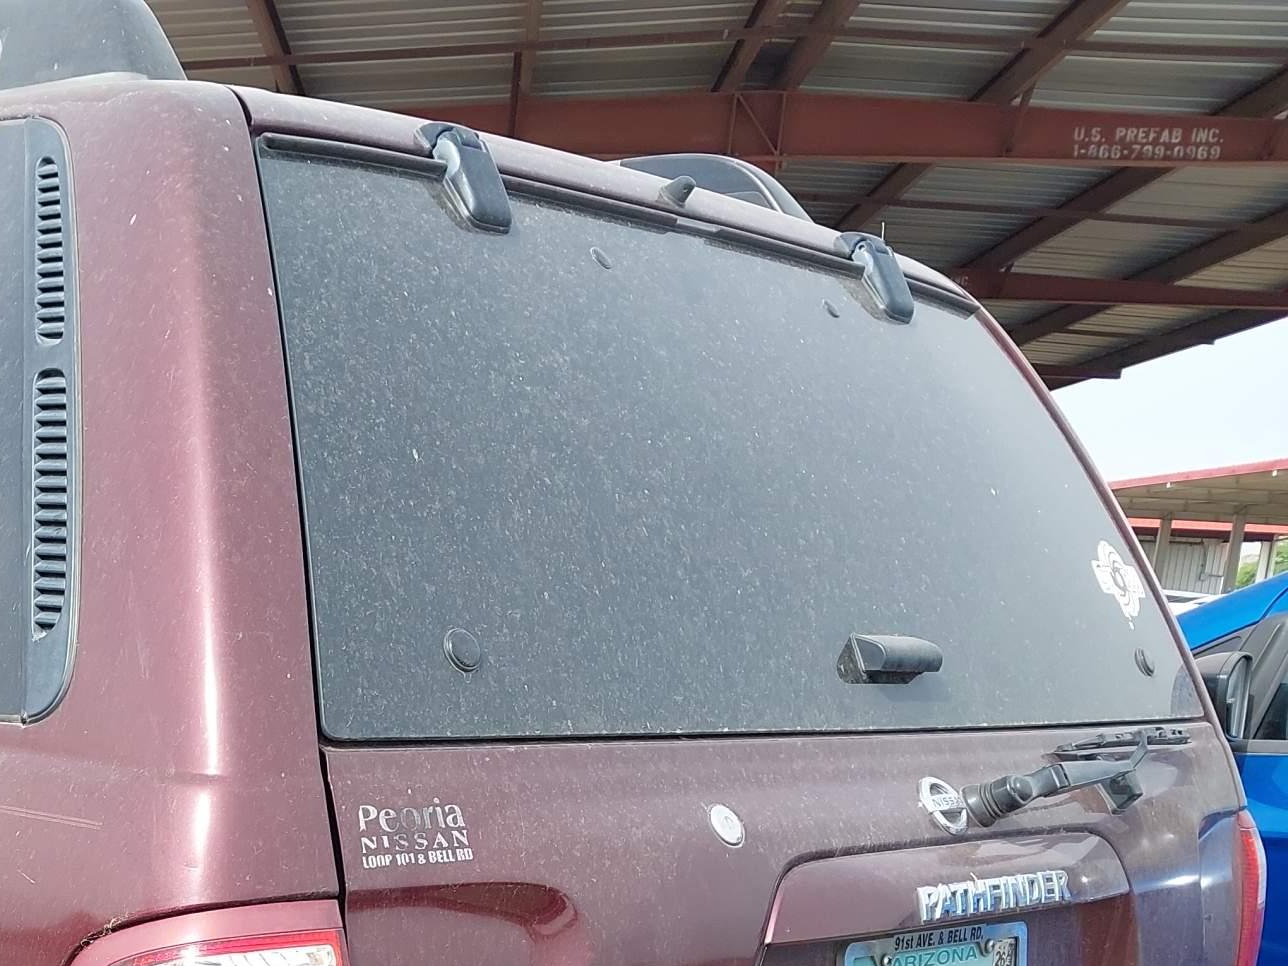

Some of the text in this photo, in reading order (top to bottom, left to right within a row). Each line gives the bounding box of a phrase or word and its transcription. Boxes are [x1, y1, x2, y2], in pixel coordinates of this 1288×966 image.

[1073, 127, 1224, 144] U.S. PREFAB INC.
[358, 797, 465, 833] Peoria
[361, 829, 470, 854] NISSAN
[362, 847, 474, 869] LOOP 101 & BELL RD
[917, 871, 1072, 924] PATHFINDER
[894, 926, 984, 951] 91st AVE. & BELL RD.
